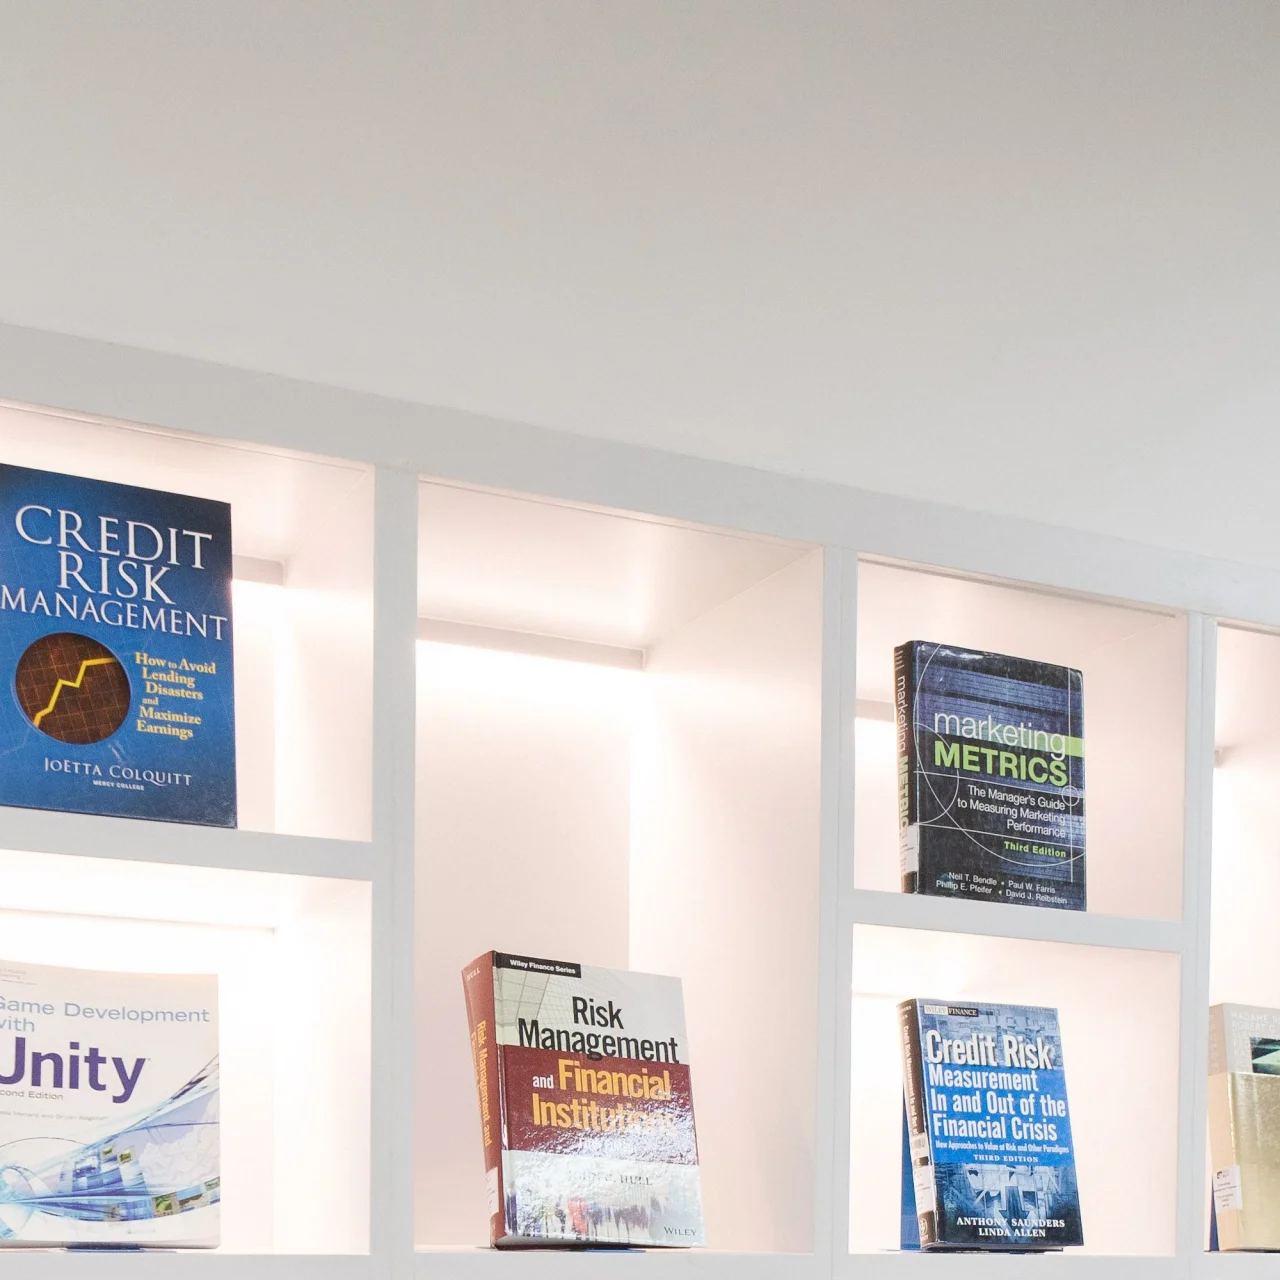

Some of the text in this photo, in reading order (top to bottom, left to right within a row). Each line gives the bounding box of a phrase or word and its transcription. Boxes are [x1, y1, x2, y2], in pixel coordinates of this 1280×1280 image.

[15, 505, 213, 570] CREDIT
[58, 550, 177, 605] RISK
[0, 585, 228, 641] MANAGEMENT
[135, 652, 216, 675] How to Avoid
[142, 667, 196, 688] Lending
[142, 696, 159, 706] and
[145, 682, 204, 701] Disasters
[139, 706, 202, 725] Maximize
[136, 720, 194, 740] Earnings
[934, 712, 1067, 761] marketing
[44, 757, 193, 788] JOETTA COLQUITT
[934, 740, 1068, 787] METRICS
[968, 784, 1066, 811] The Manager's Guide
[957, 797, 1066, 826] to Measuring Marketing
[1007, 819, 1066, 838] Performance
[1004, 841, 1067, 858] Third Edition
[1006, 889, 1026, 898] David
[1008, 880, 1024, 889] Paul
[1036, 884, 1056, 893] Farris
[509, 959, 576, 974] Wiley Finance Series
[64, 1002, 210, 1024] Development
[572, 996, 624, 1030] Risk
[948, 1007, 977, 1016] FINANCE
[518, 1017, 680, 1064] Management
[925, 1030, 1053, 1069] Credit Risk
[532, 1058, 672, 1101] and Financial
[928, 1064, 1038, 1092] Measurement
[28, 1090, 64, 1100] Edition
[931, 1088, 1066, 1117] In and Out of the
[933, 1113, 1058, 1141] Financial Crisis
[663, 1225, 697, 1237] WILEY
[956, 1217, 1065, 1227] ANTHONY SAUNDERS
[978, 1228, 1046, 1237] LINDA ALLEN
